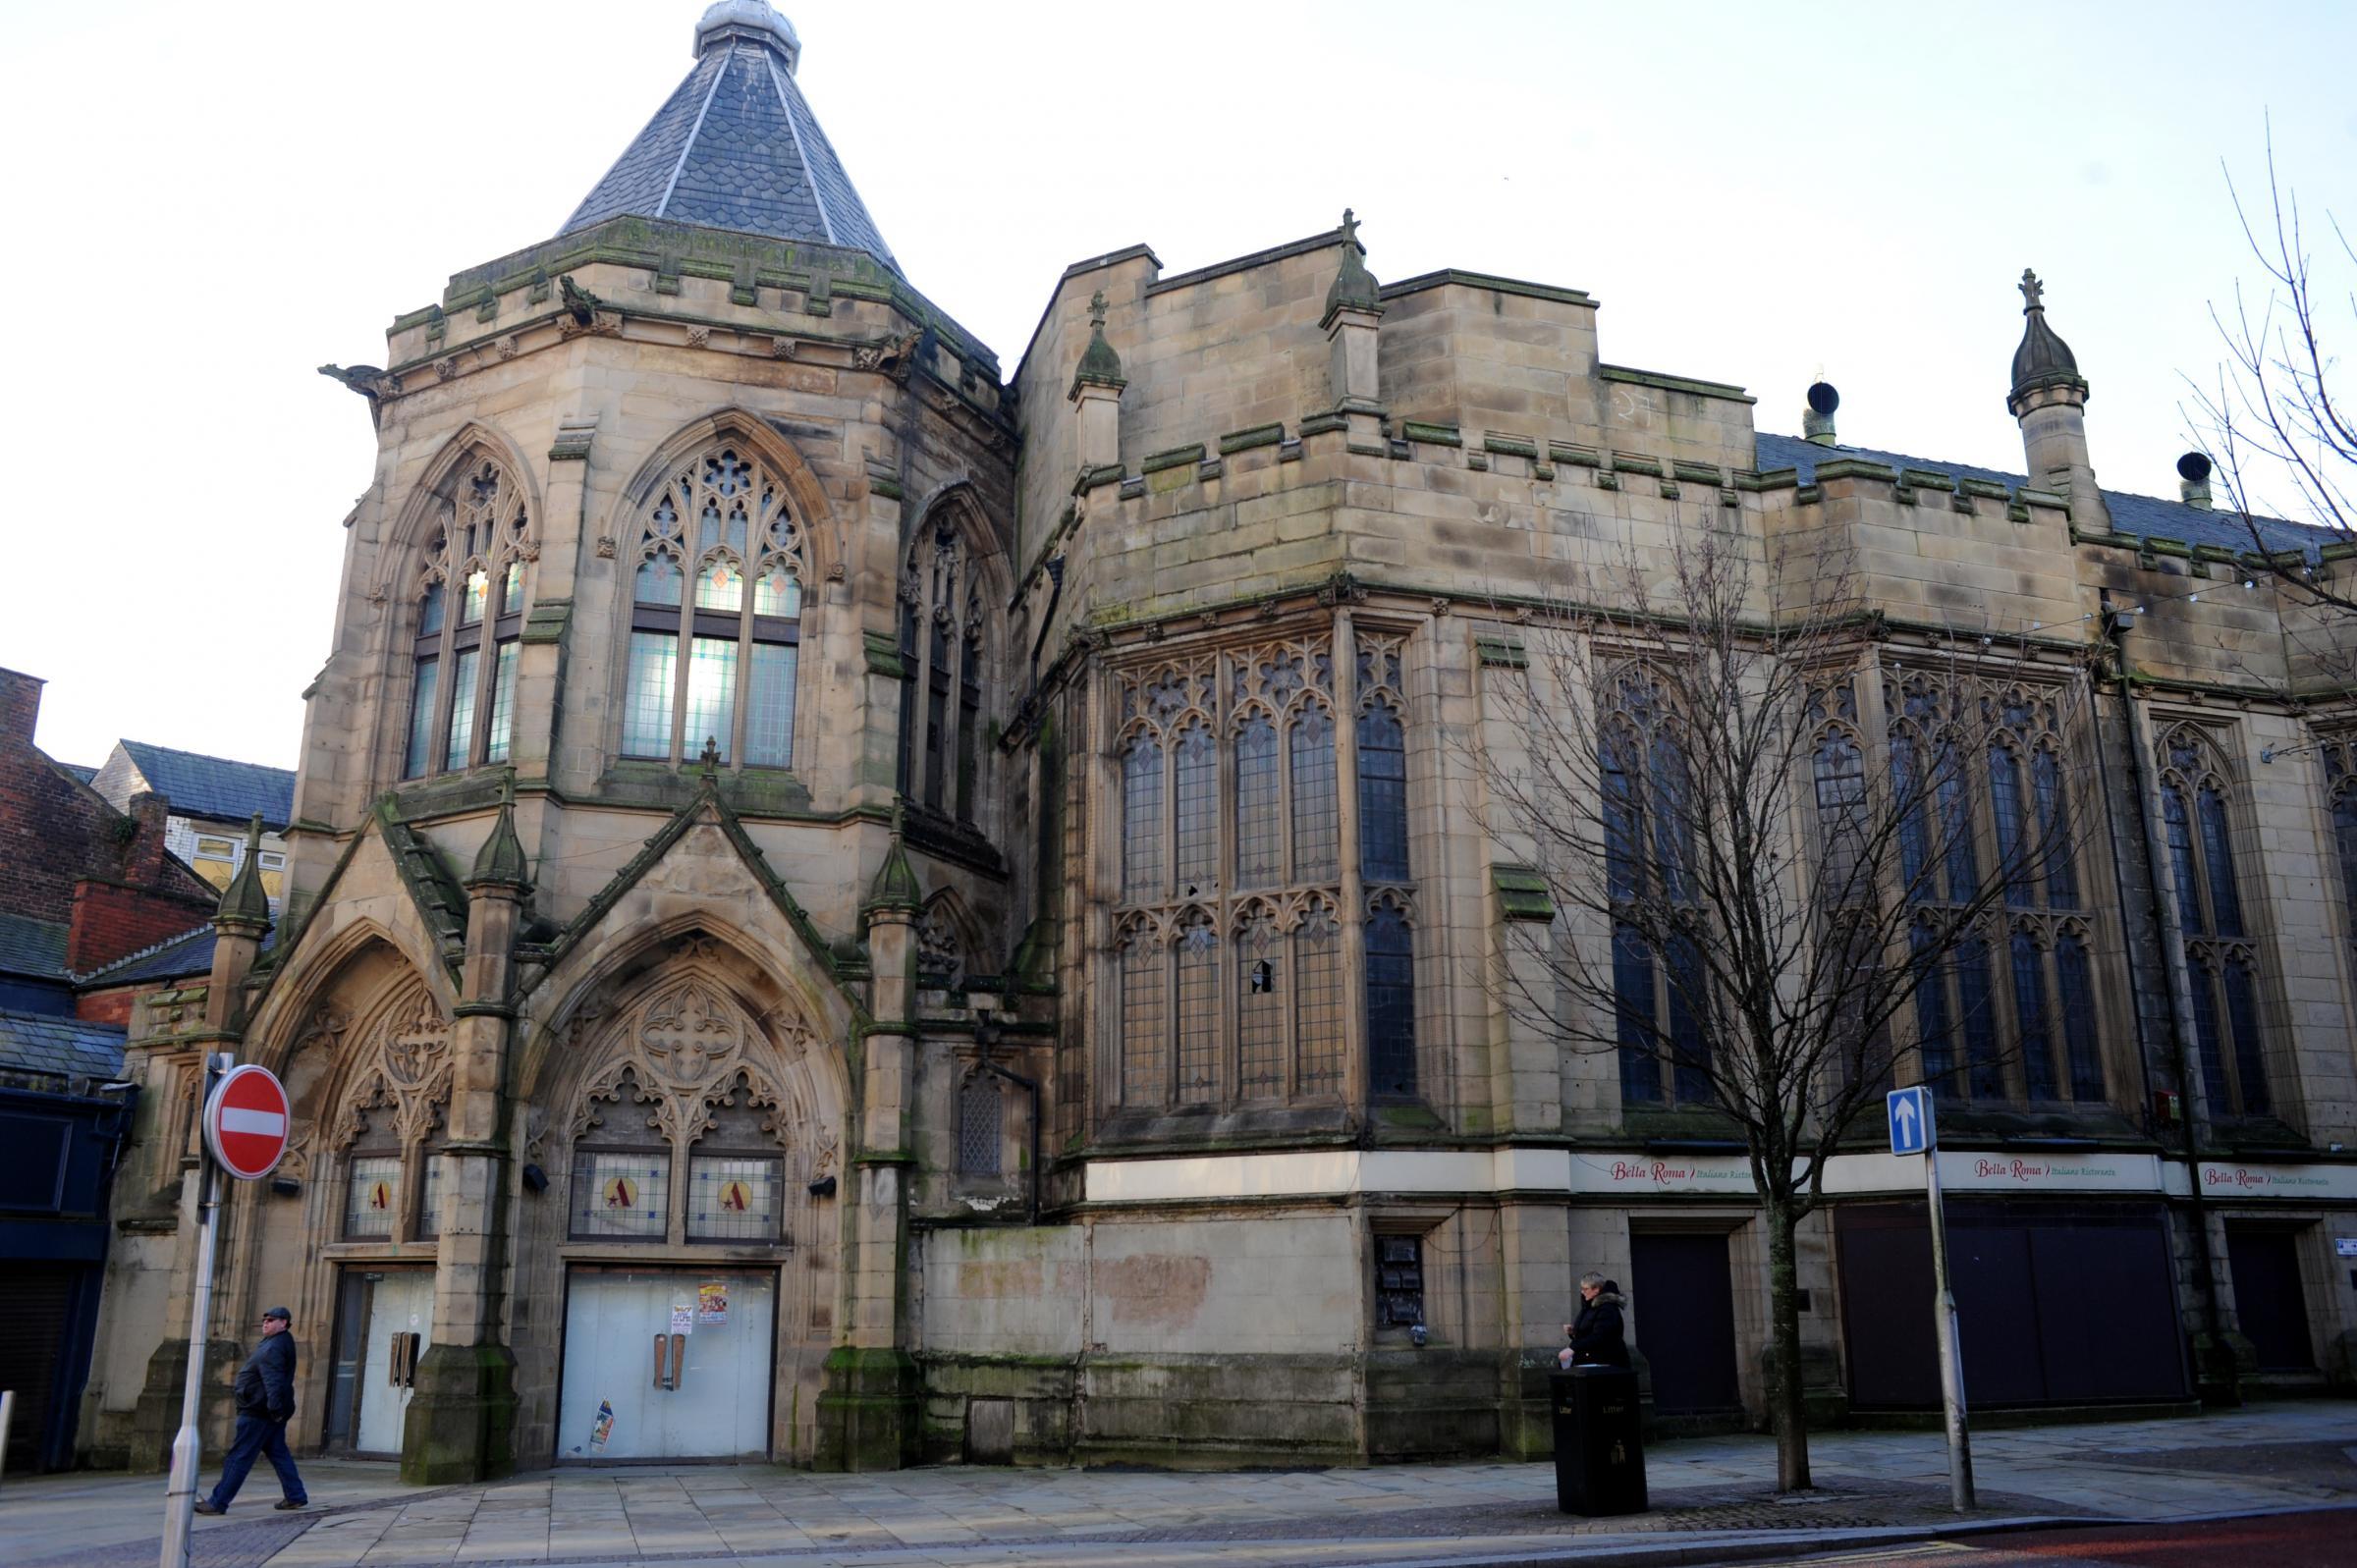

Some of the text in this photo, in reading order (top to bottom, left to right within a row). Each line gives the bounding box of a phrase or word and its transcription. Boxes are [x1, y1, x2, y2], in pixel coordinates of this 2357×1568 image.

[1611, 1161, 1646, 1180] Bella
[1651, 1162, 1685, 1185] Roma
[1696, 1169, 1728, 1179] Italiano
[1975, 1159, 2006, 1178] Bella
[2010, 1160, 2042, 1182] Roma
[2204, 1168, 2232, 1186] Bella
[2235, 1168, 2264, 1190] Roma
